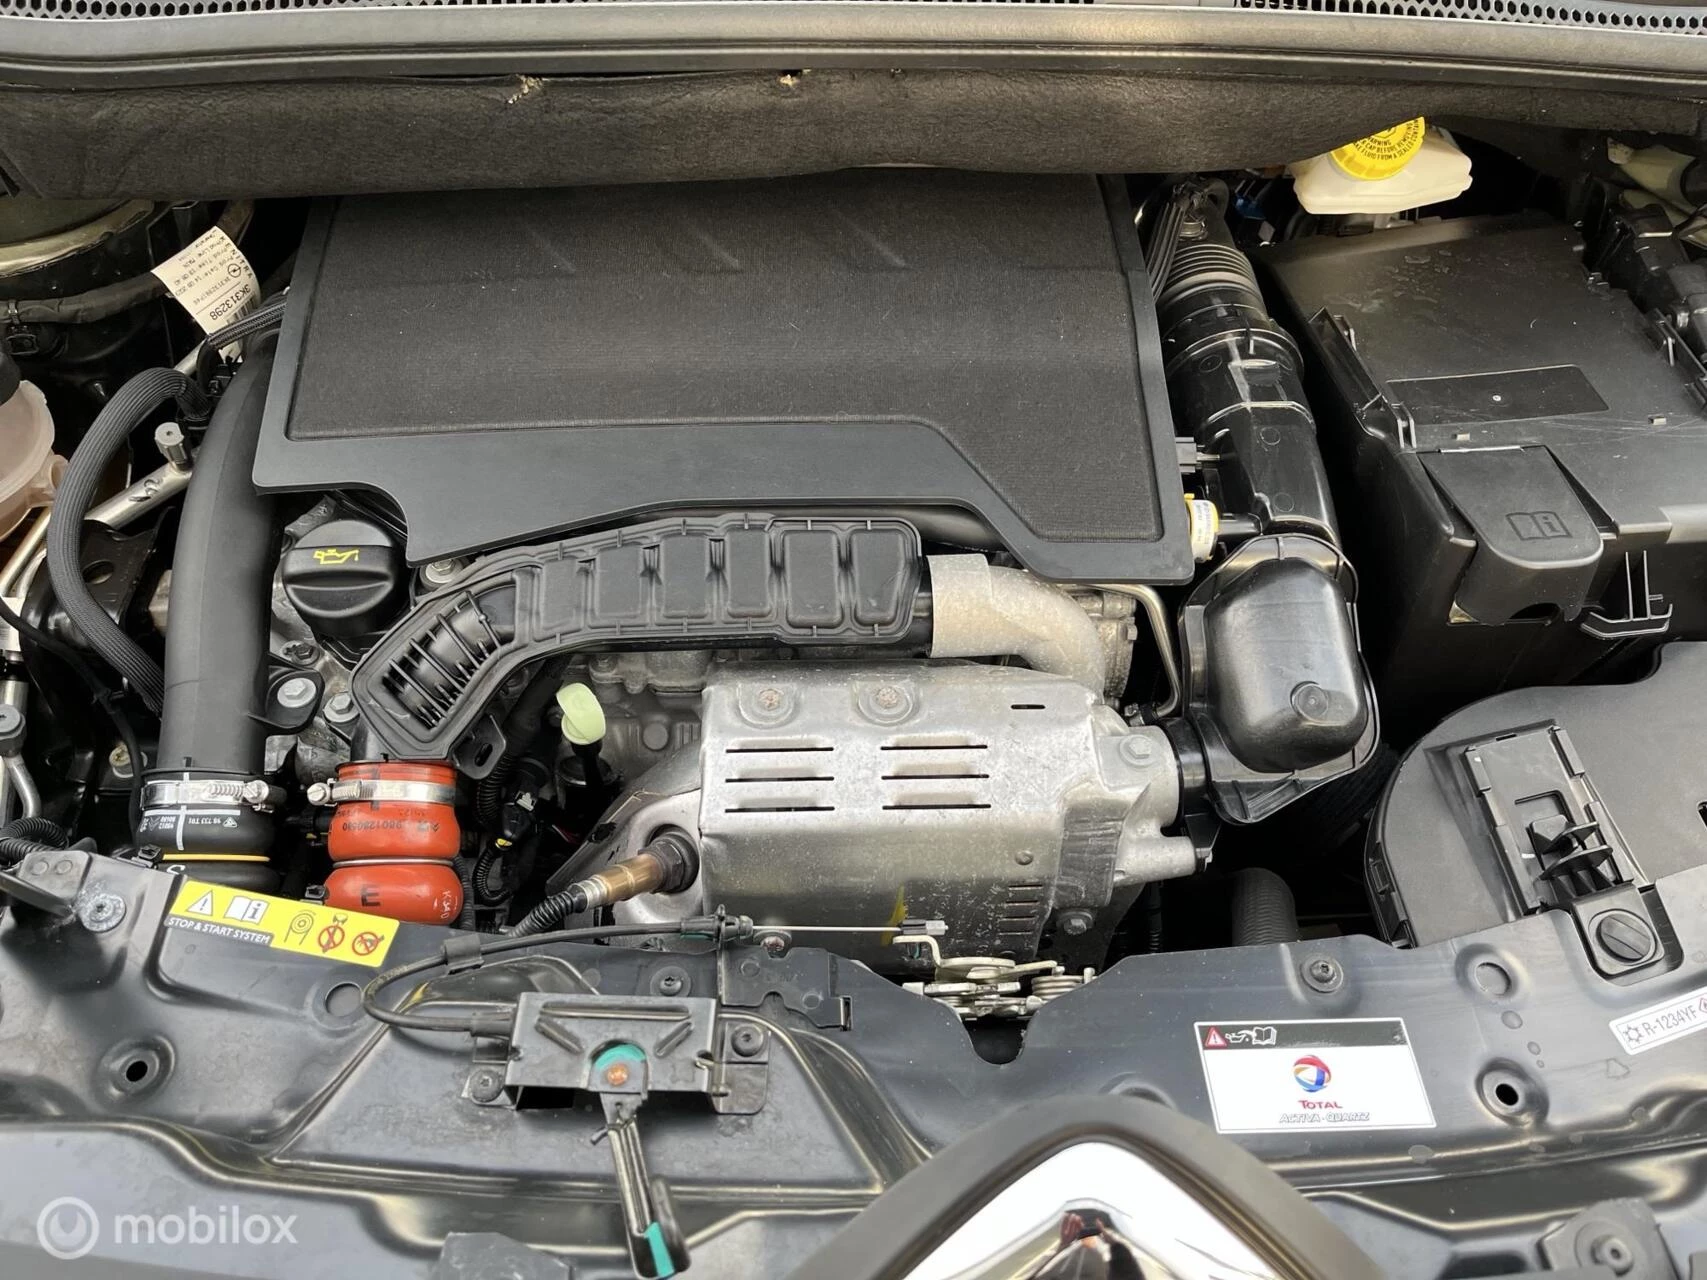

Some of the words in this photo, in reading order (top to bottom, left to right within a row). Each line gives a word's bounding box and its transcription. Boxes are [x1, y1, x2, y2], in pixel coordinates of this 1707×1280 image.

[209, 283, 251, 321] 3K313298
[168, 917, 195, 929] STOP
[194, 922, 201, 931] &
[202, 923, 234, 936] START
[233, 929, 270, 944] SYSTEM
[1642, 1005, 1697, 1036] R-1234YF
